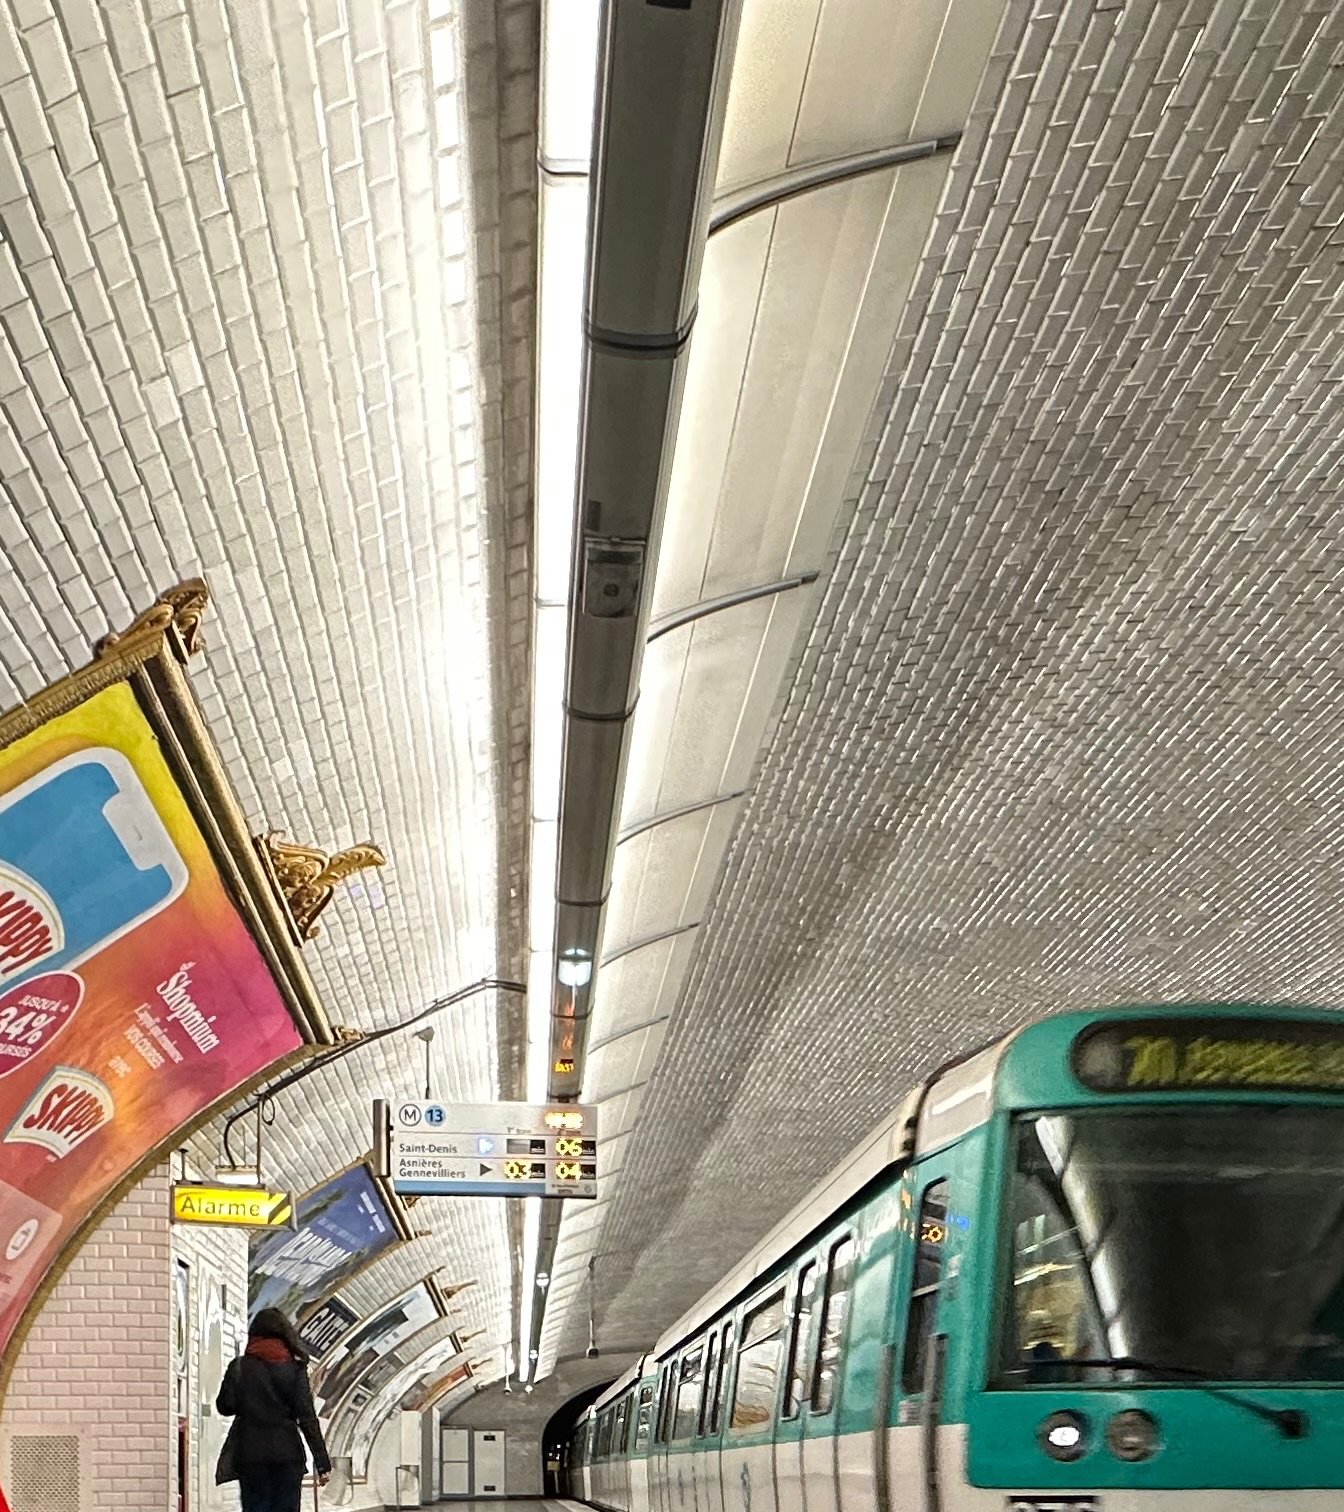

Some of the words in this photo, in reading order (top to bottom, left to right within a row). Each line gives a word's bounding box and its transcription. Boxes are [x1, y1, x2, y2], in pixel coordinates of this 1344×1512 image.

[156, 970, 220, 1054] Shopmium
[22, 1083, 106, 1145] SKIPPY
[427, 1110, 444, 1123] 13
[399, 1142, 458, 1155] Saint-Denis
[556, 1137, 583, 1157] 06
[399, 1158, 443, 1169] Asnières
[399, 1168, 466, 1179] Gennevilliers
[556, 1161, 582, 1181] 04
[180, 1196, 261, 1217] Alarme
